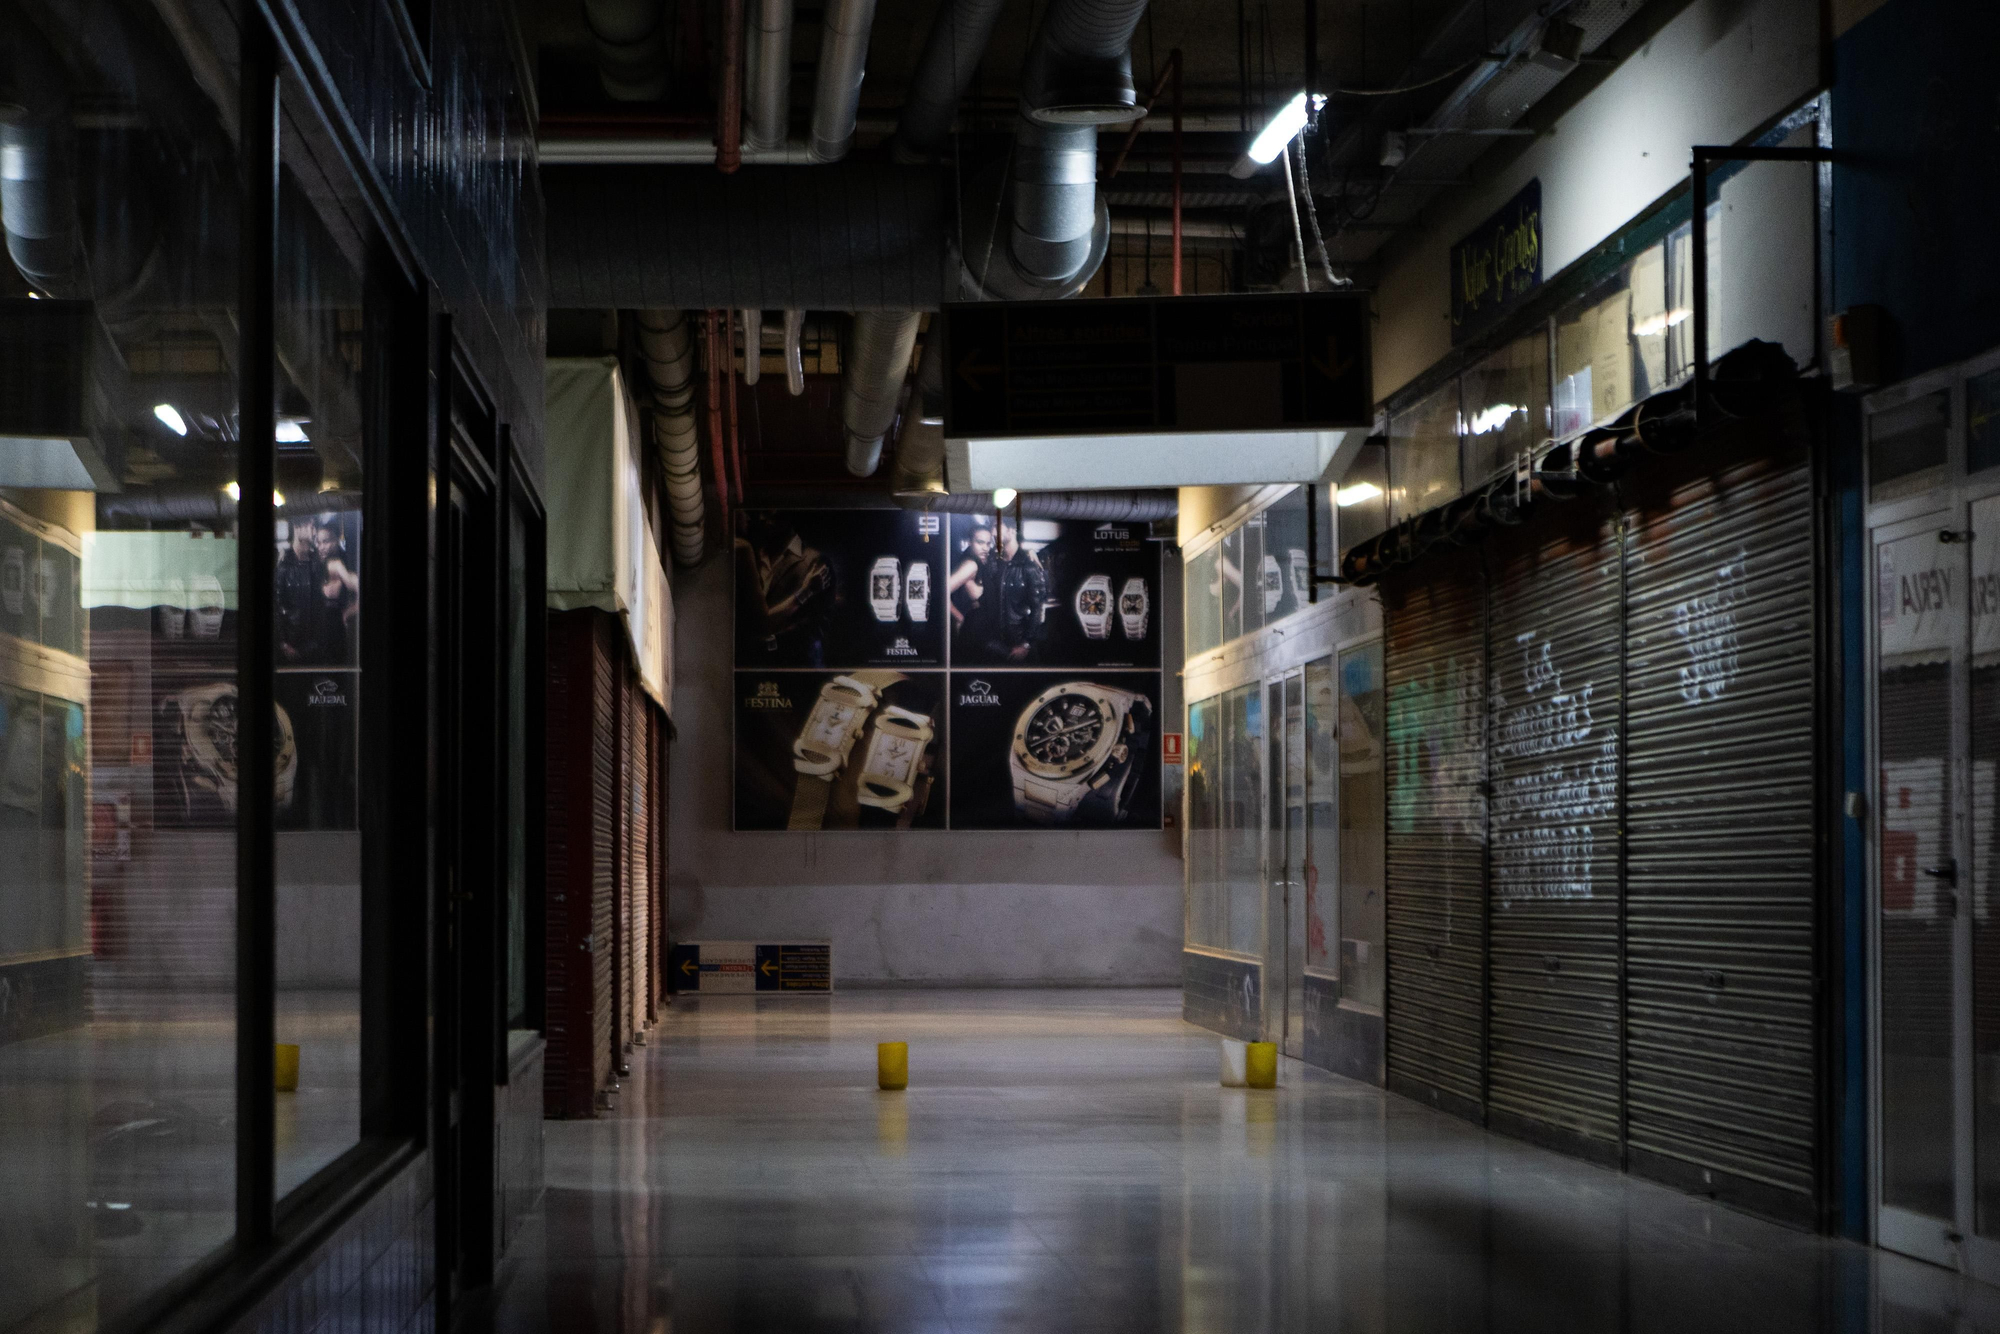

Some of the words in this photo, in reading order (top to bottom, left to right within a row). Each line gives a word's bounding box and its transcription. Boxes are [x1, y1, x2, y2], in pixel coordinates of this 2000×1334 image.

[1015, 325, 1066, 341] Altres
[1072, 323, 1146, 341] sortides
[1163, 337, 1217, 354] Teatre
[1222, 334, 1298, 354] Principal
[1094, 531, 1130, 540] LOTUS
[885, 648, 918, 656] FESTINA
[744, 698, 793, 708] FESTINA
[958, 694, 1002, 707] JAGUAR
